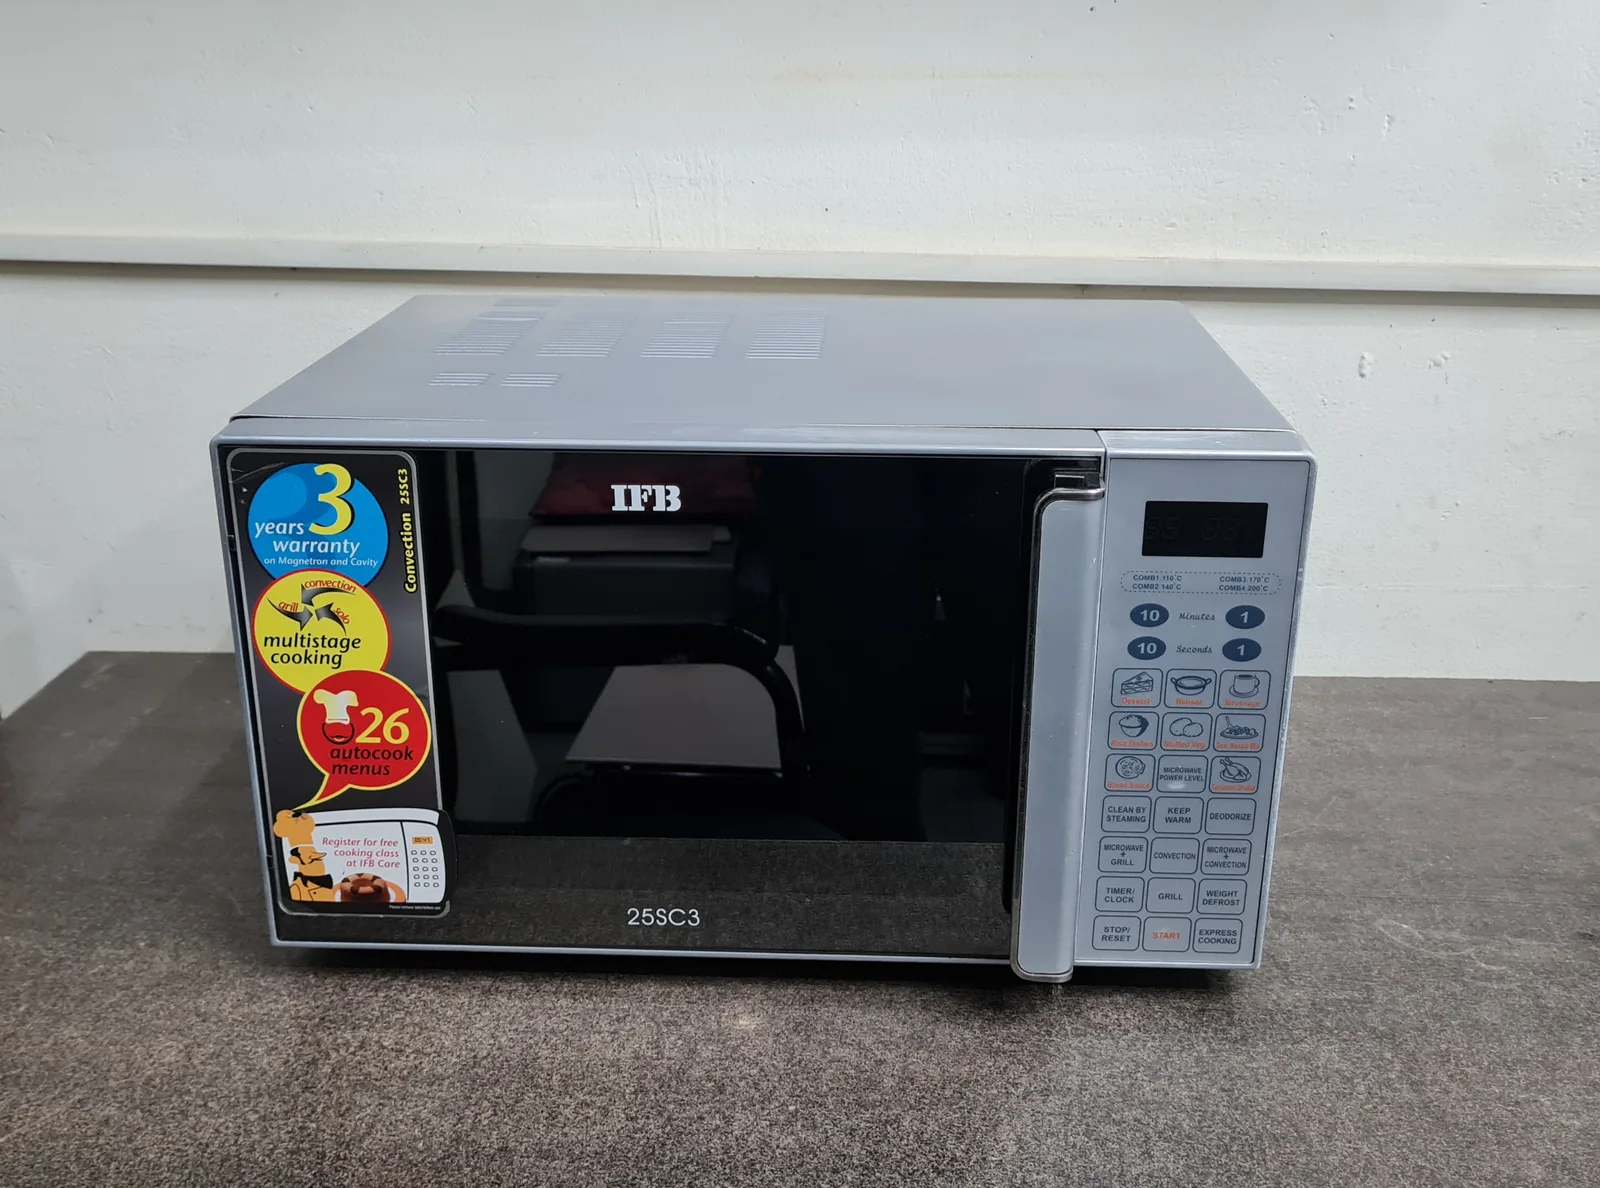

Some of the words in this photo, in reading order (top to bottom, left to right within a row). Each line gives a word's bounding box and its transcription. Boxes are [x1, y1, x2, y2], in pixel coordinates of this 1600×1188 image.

[398, 468, 410, 505] 25SC3
[308, 463, 352, 536] 3
[610, 484, 681, 512] IFB
[254, 521, 304, 538] years
[272, 539, 360, 557] warranty
[400, 512, 417, 593] Convection
[264, 557, 276, 565] on
[278, 556, 328, 567] Magnetron
[330, 557, 348, 566] and
[350, 557, 379, 568] Cavity
[1219, 575, 1247, 583] COMB3
[304, 579, 356, 593] convection
[278, 601, 299, 612] grill
[333, 607, 350, 625] solo
[1140, 610, 1160, 622] 10
[1178, 612, 1216, 621] Minutes
[1240, 612, 1249, 623] 1
[263, 632, 361, 653] multistage
[1137, 643, 1158, 654] 10
[1176, 645, 1213, 654] Seconds
[1237, 644, 1246, 656] 1
[271, 649, 343, 669] cooking
[355, 706, 410, 745] 26
[329, 746, 414, 761] autocook
[331, 763, 391, 776] menus
[1163, 766, 1203, 774] MICROWAVE
[1159, 774, 1183, 782] POWER
[1107, 805, 1134, 814] CLEAN
[1135, 806, 1147, 814] BY
[1167, 807, 1191, 815] KEEP
[1106, 815, 1147, 823] STEAMING
[1164, 816, 1192, 824] WARM
[1209, 812, 1252, 821] DEODORIZE
[322, 837, 361, 848] Register
[363, 837, 377, 846] for
[379, 837, 399, 847] free
[1103, 844, 1144, 852] MICROWAVE
[1206, 846, 1248, 854] MICROWAVE
[333, 847, 373, 859] cooking
[375, 849, 400, 858] class
[1153, 852, 1196, 860] CONVECTION
[346, 860, 357, 868] at
[359, 859, 375, 868] IFB
[377, 859, 400, 869] Care
[1110, 858, 1135, 866] GRILL
[1204, 860, 1247, 869] CONVECTION
[1106, 887, 1136, 895] TIMER/
[1206, 890, 1238, 898] WEIGHT
[1157, 893, 1183, 901] GRILL
[1202, 898, 1240, 906] DEFROST
[627, 907, 700, 927] 25SC3
[1103, 926, 1131, 934] STOP/
[1198, 929, 1238, 937] EXPRESS
[1101, 934, 1132, 942] RESET
[1152, 932, 1181, 940] START
[1197, 937, 1237, 945] COOKING
